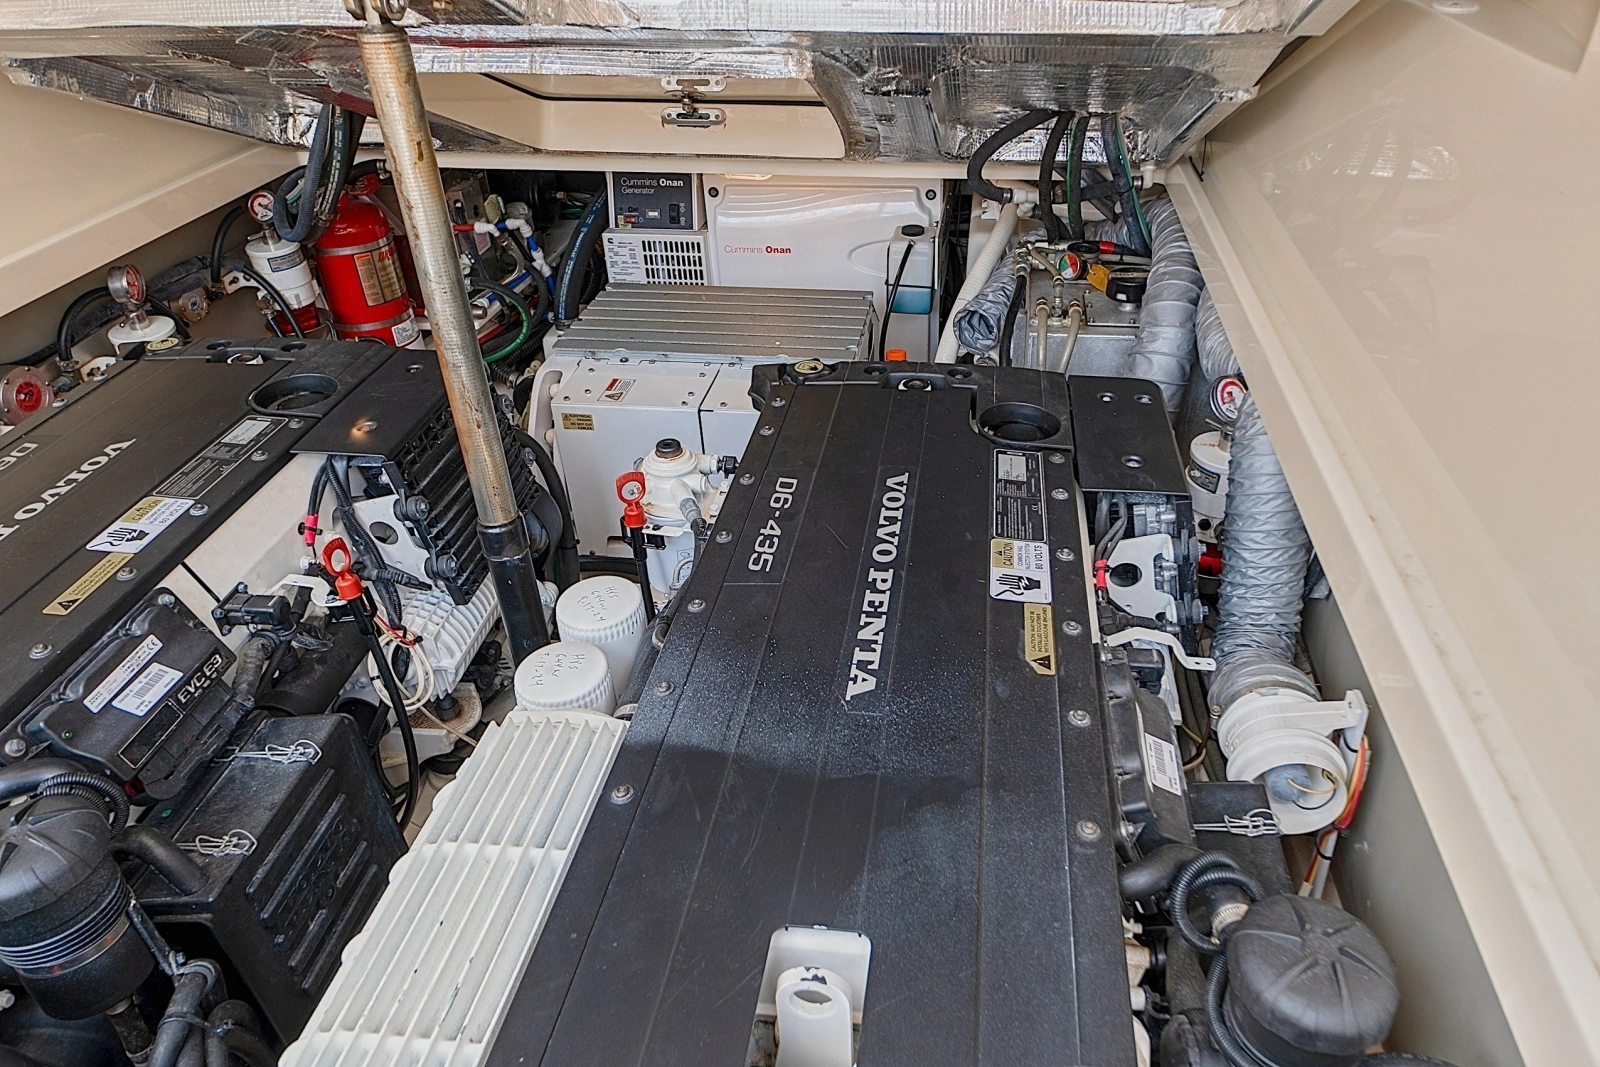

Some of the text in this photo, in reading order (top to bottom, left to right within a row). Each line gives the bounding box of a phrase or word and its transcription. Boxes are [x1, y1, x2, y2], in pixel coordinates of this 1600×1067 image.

[621, 177, 684, 187] Cummins Onan
[621, 186, 655, 195] Generator
[724, 245, 792, 254] Cummins Onan
[14, 438, 137, 520] VOLVO
[132, 499, 164, 521] CAUTION
[167, 501, 189, 517] VOLTS
[748, 476, 798, 572] D6-435
[1003, 542, 1013, 566] CAUTION
[1034, 545, 1042, 562] VOLTS
[845, 472, 909, 701] VOLVO PENTA
[177, 672, 205, 704] EVC
[203, 654, 222, 677] E3
